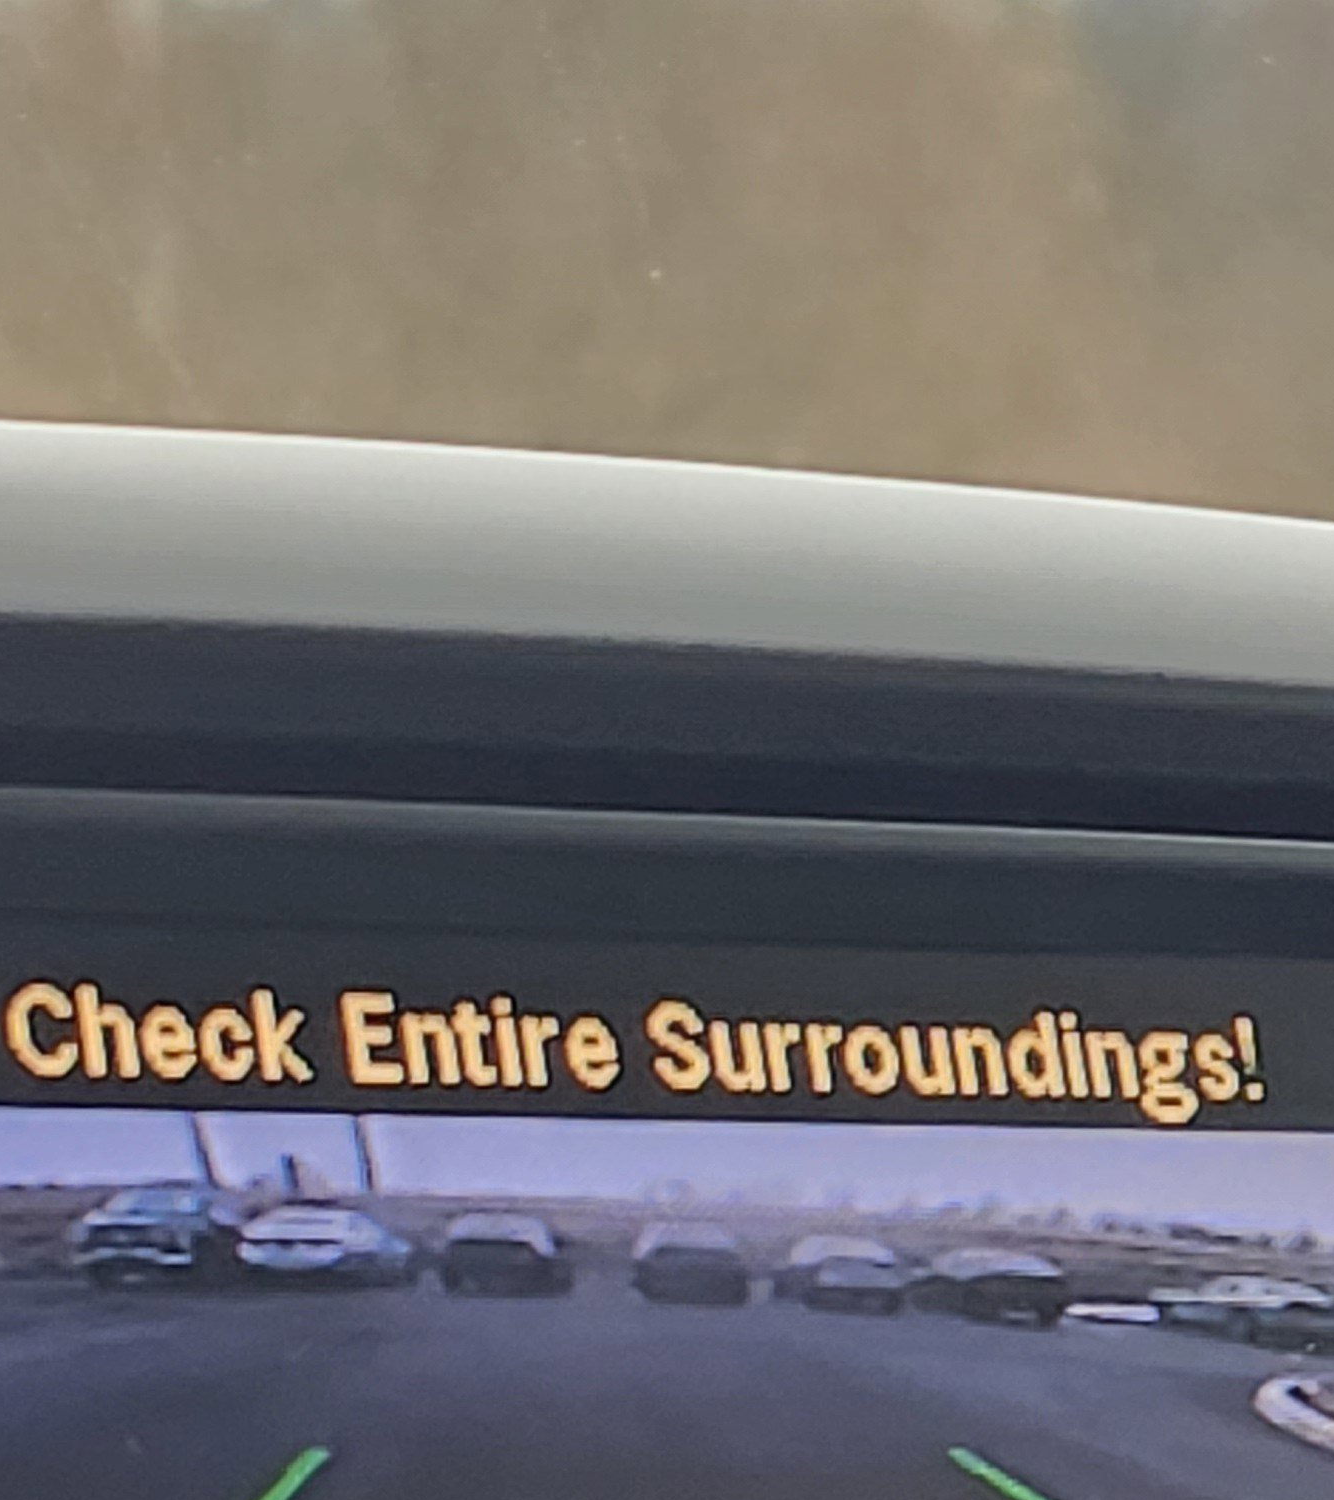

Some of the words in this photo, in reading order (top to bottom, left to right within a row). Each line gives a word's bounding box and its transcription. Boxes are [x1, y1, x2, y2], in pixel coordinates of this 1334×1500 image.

[5, 982, 315, 1084] Check
[340, 990, 621, 1090] Entire
[644, 1000, 1266, 1123] Surroundings!
